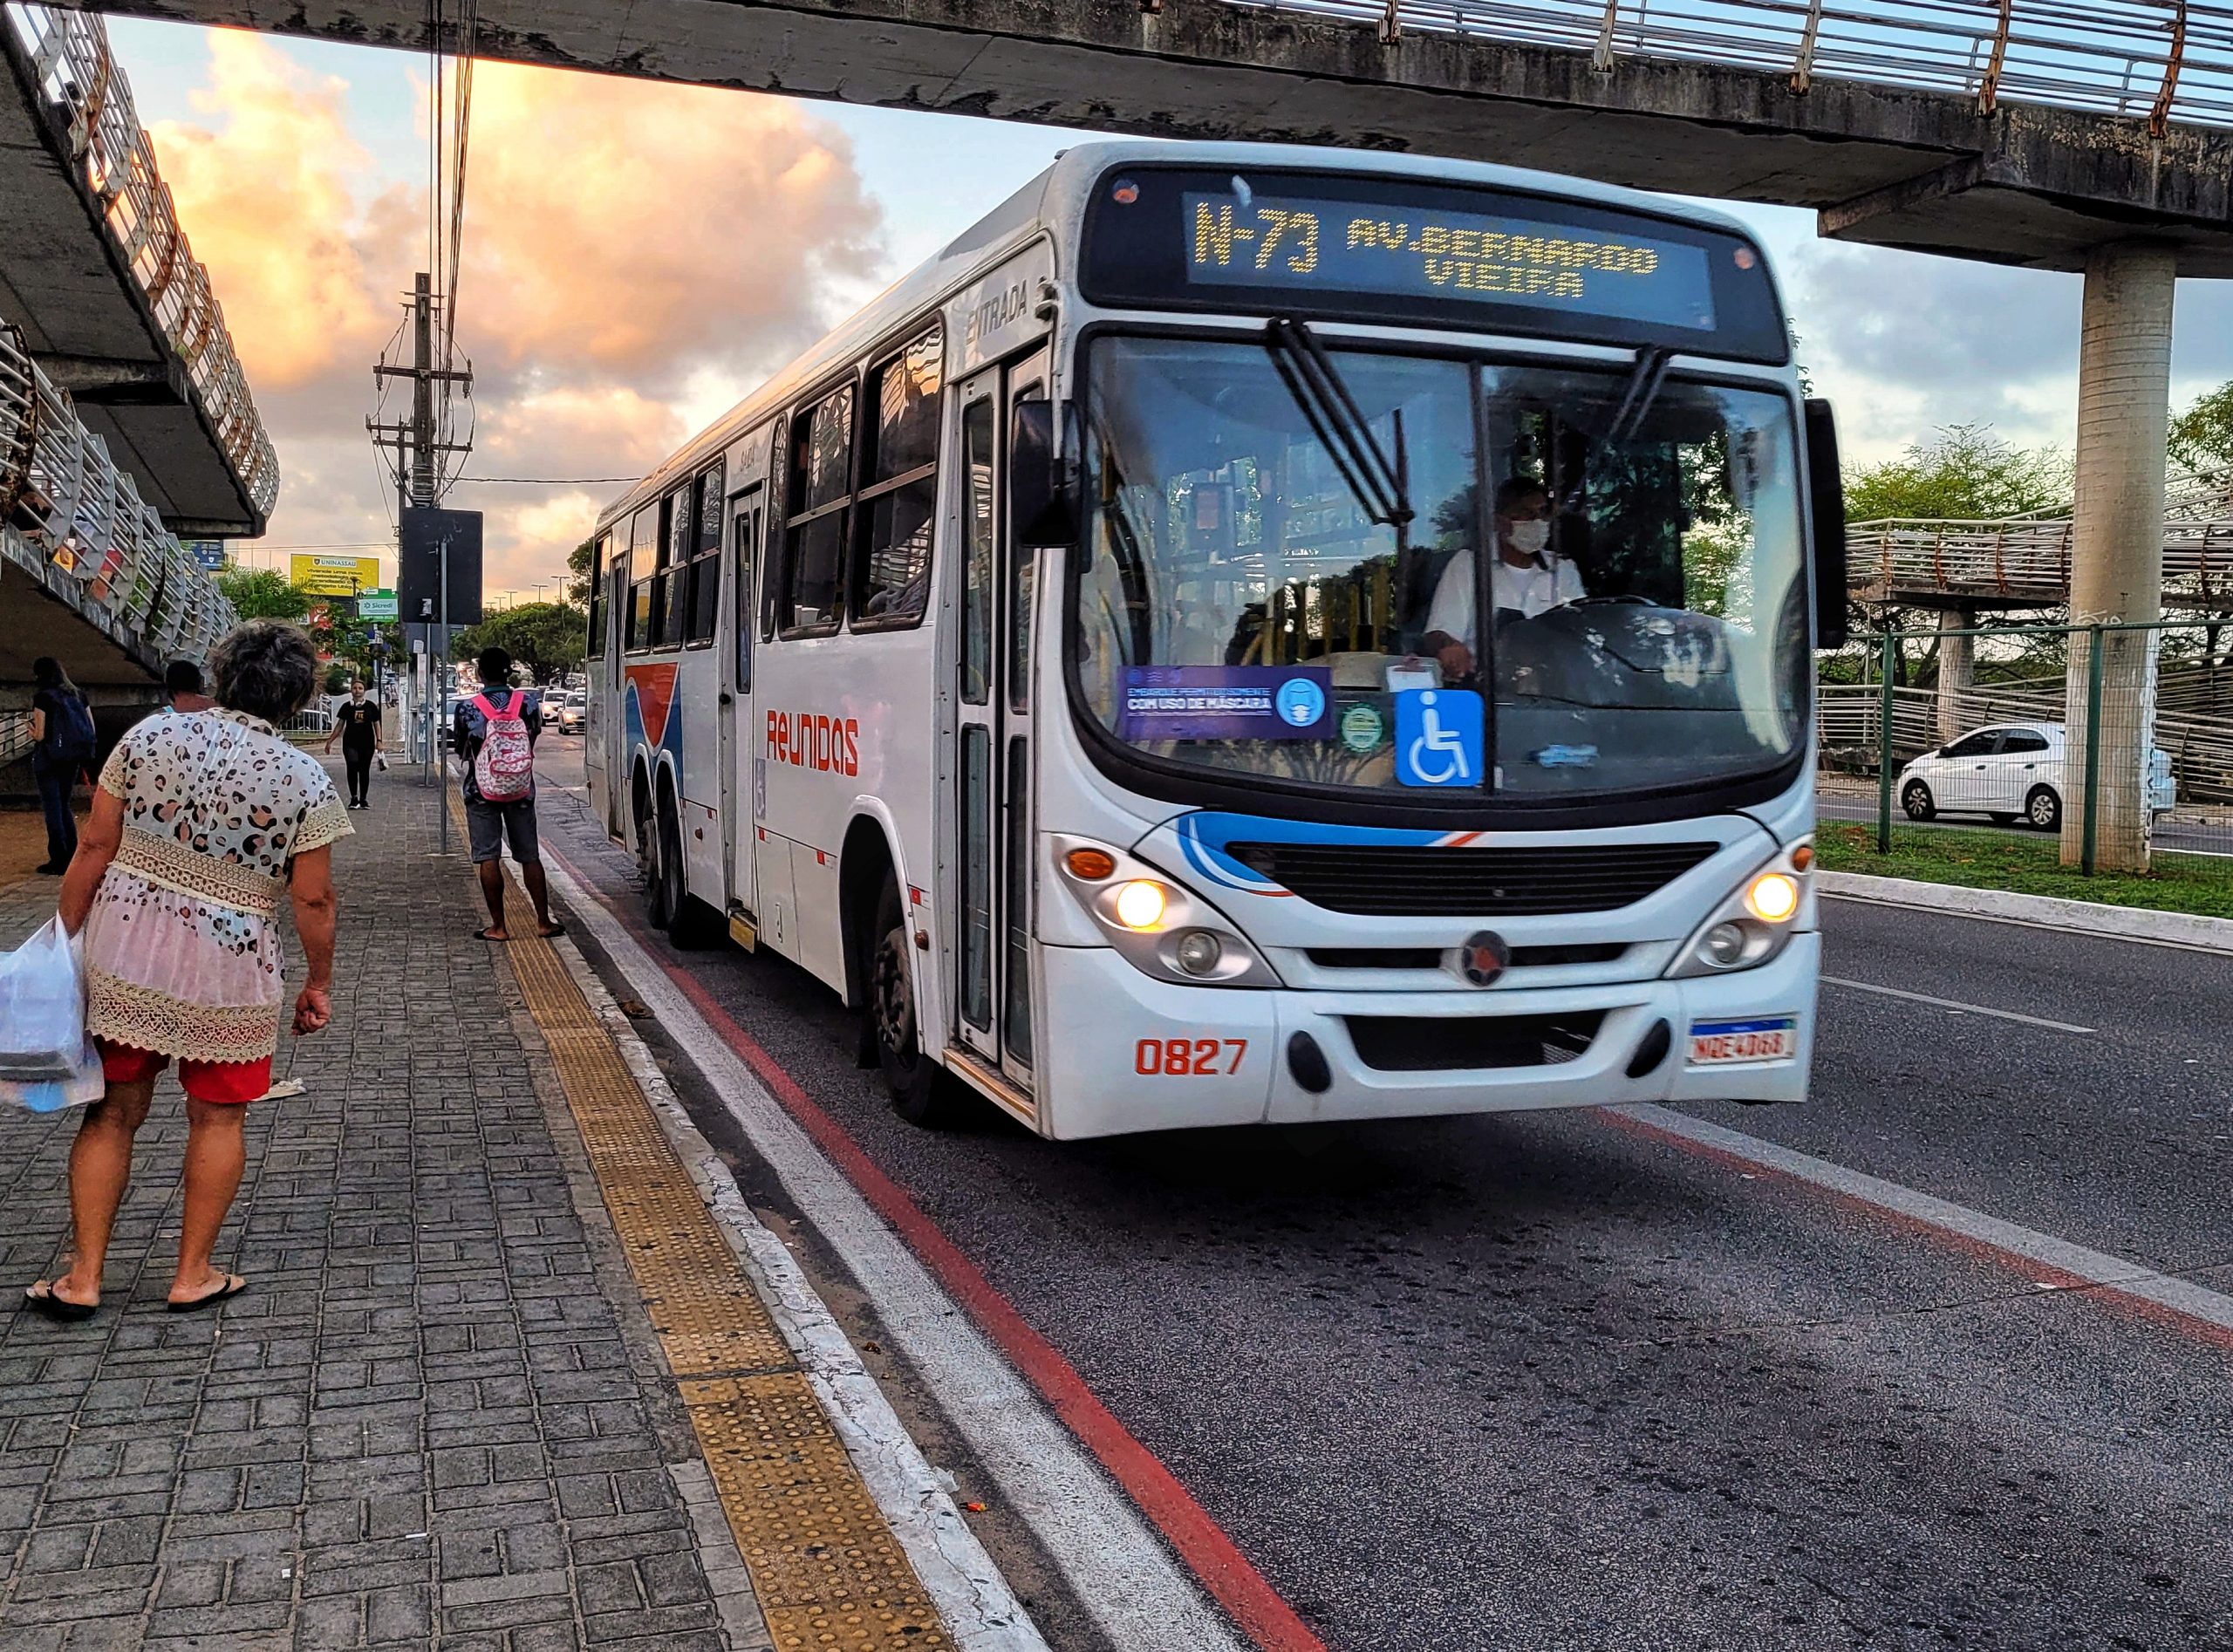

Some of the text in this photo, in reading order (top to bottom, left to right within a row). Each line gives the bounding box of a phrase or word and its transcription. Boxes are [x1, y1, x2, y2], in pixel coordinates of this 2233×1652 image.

[1194, 201, 1319, 273] N-73
[1424, 258, 1584, 298] VIEIRA
[1127, 695, 1273, 710] COM USO DE MÁSCARA
[1136, 1039, 1248, 1075] 0827
